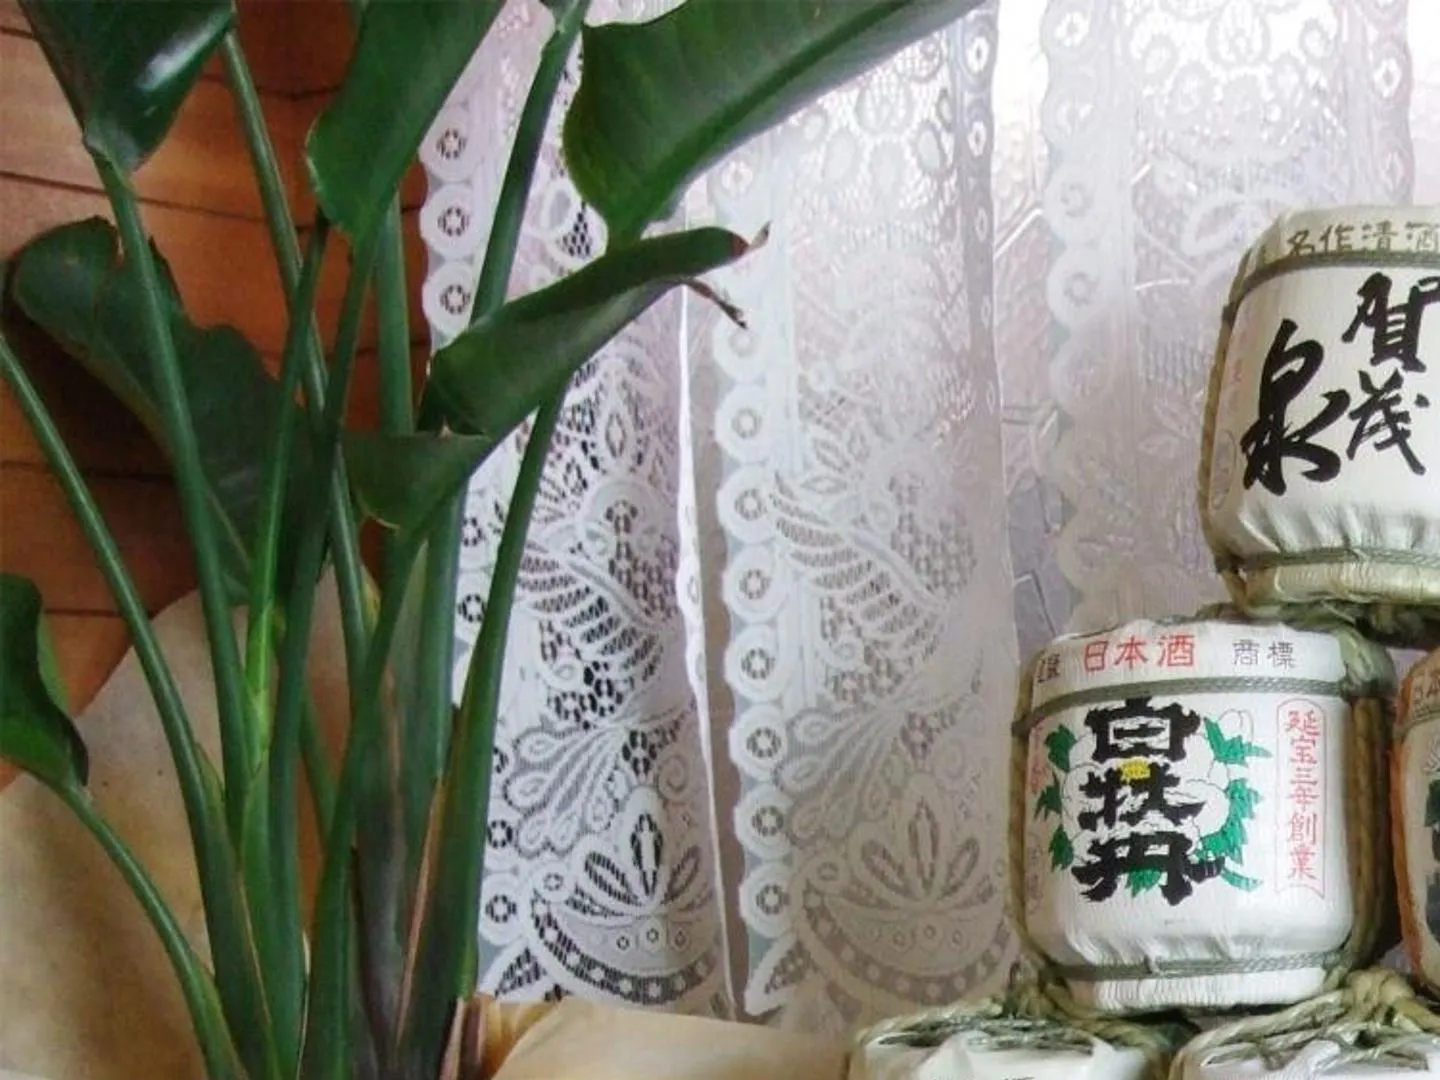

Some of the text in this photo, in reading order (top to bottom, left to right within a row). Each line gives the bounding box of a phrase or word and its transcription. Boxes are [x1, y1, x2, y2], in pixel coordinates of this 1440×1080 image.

[1083, 634, 1197, 673] 日本酒
[1232, 639, 1297, 669] 商標
